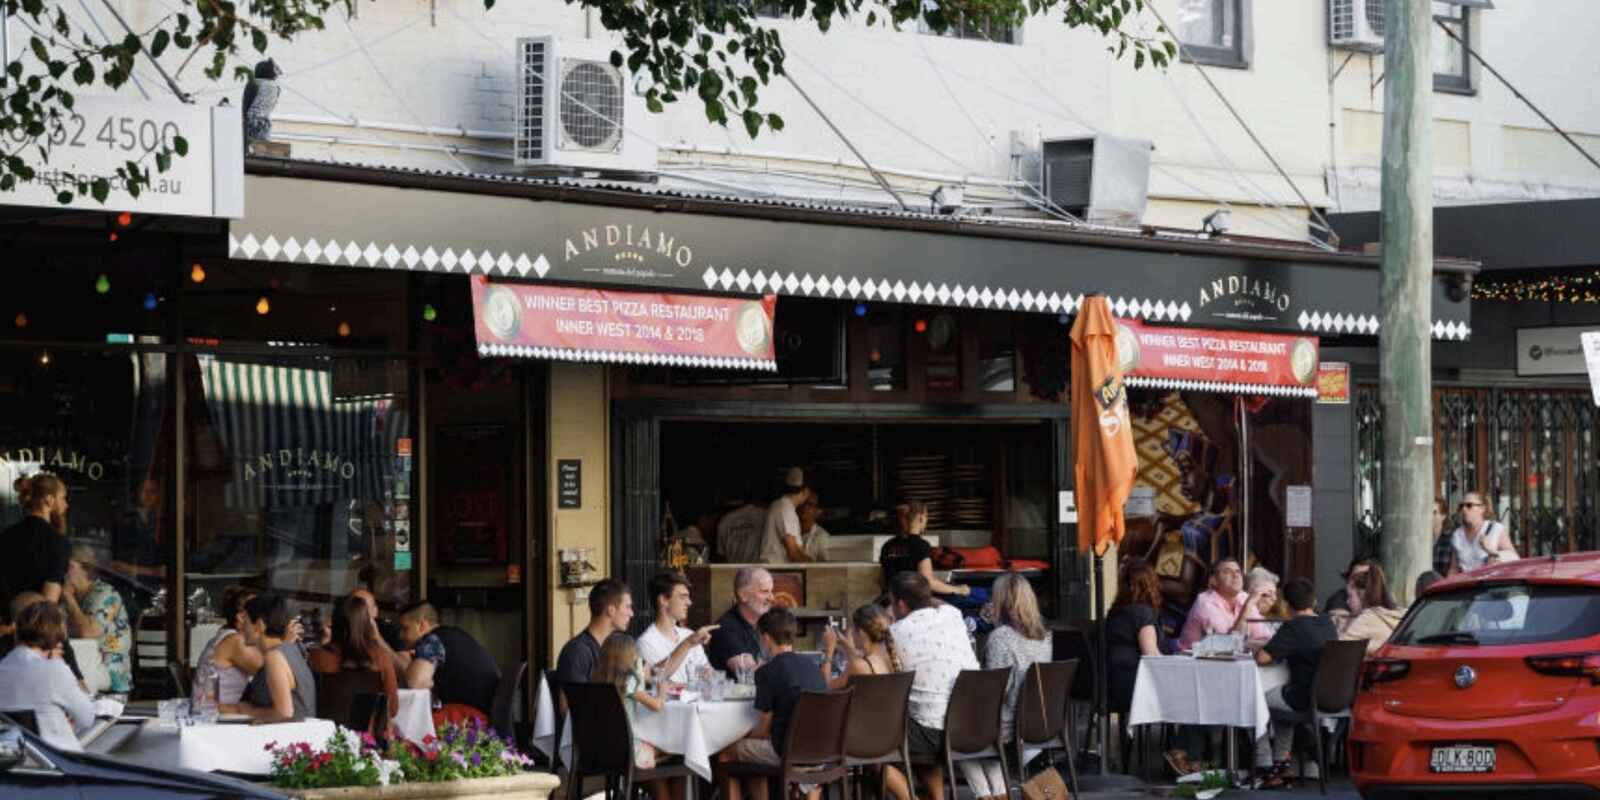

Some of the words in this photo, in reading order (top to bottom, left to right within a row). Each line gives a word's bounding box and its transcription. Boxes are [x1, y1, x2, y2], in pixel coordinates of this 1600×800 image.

[96, 116, 180, 154] 4500
[565, 224, 692, 267] ANDIAMO
[524, 295, 576, 311] WINNER
[578, 299, 609, 314] BEST
[612, 301, 647, 317] PIZZA
[651, 305, 730, 322] RESTAURANT
[1199, 275, 1290, 312] ANDIAMO
[555, 318, 593, 336] INNER
[597, 322, 633, 338] WEST
[636, 324, 662, 341] 2014
[664, 327, 673, 341] &
[1139, 333, 1177, 347] WINNER
[1177, 335, 1200, 348] BEST
[1201, 337, 1226, 351] PIZZA
[1228, 339, 1286, 355] RESTAURANT
[1163, 354, 1191, 367] INNER
[1192, 355, 1215, 369] WEST
[244, 447, 354, 481] ANDIAMO
